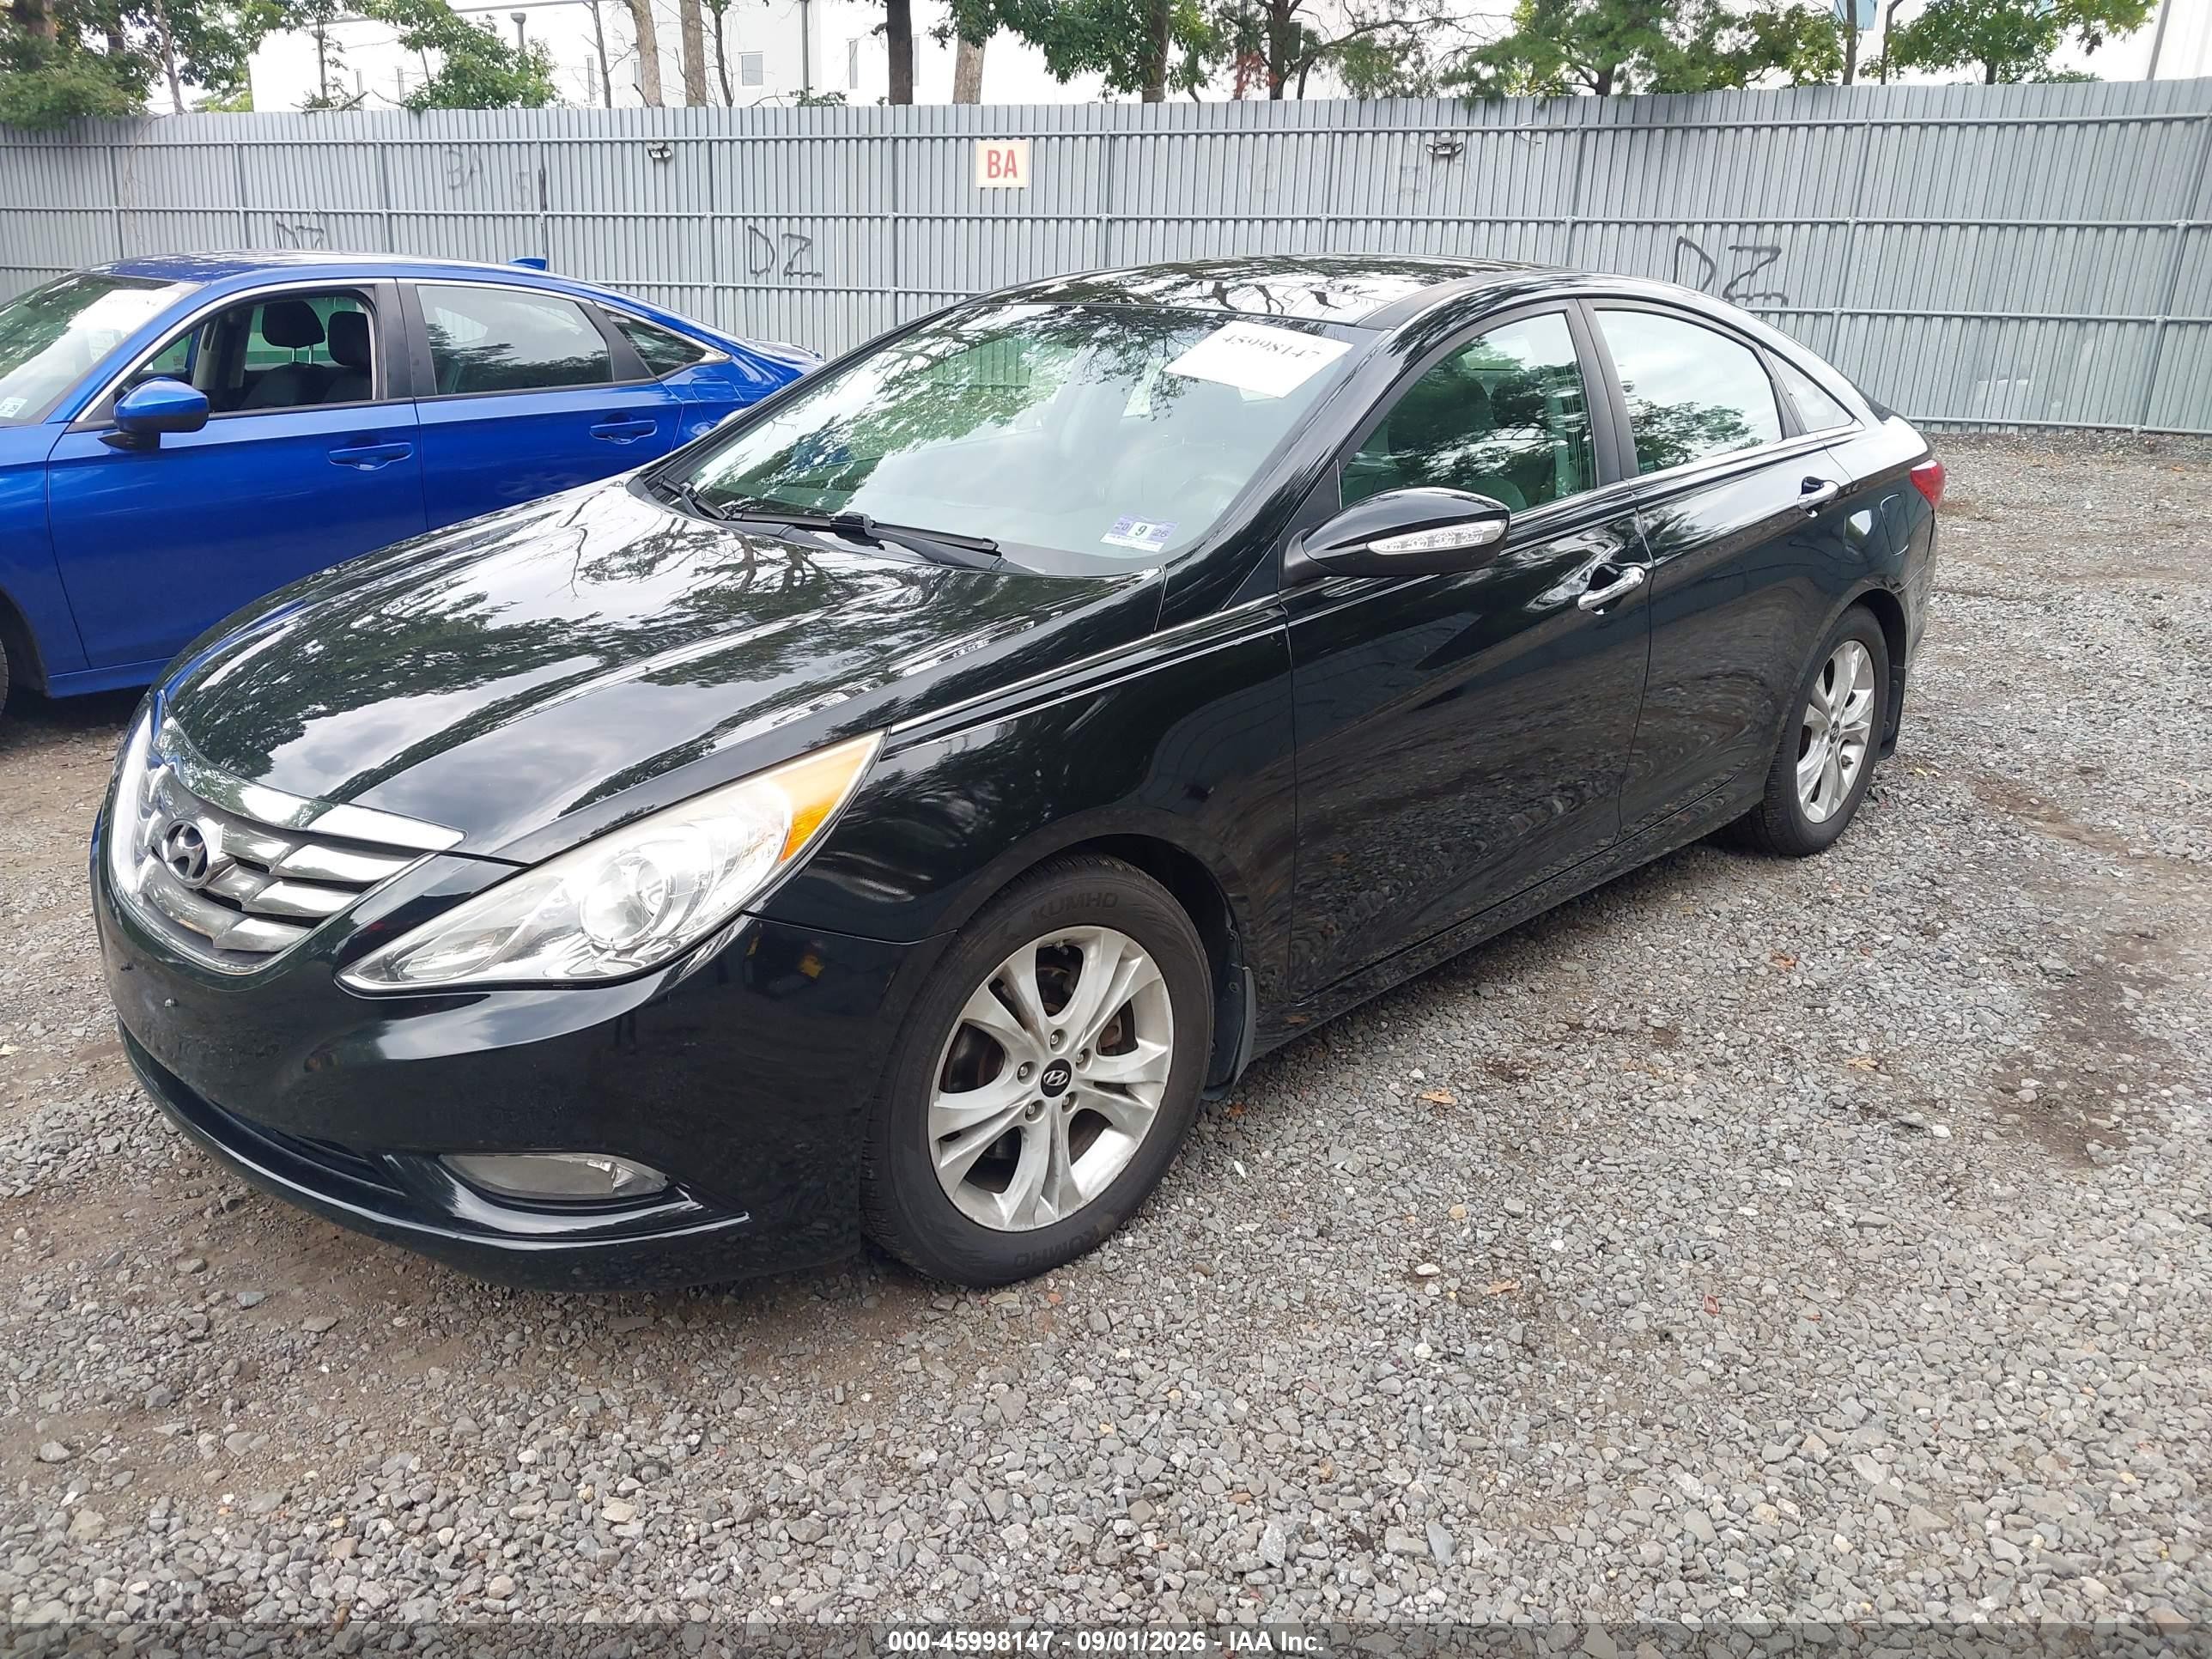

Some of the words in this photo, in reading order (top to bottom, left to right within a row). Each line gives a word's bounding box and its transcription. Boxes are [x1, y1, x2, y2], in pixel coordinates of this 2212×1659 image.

[988, 149, 1018, 179] BA
[748, 225, 823, 277] DZ
[1673, 235, 1789, 307] DZ
[1135, 525, 1148, 537] 9
[1030, 892, 1119, 925] KUMHO
